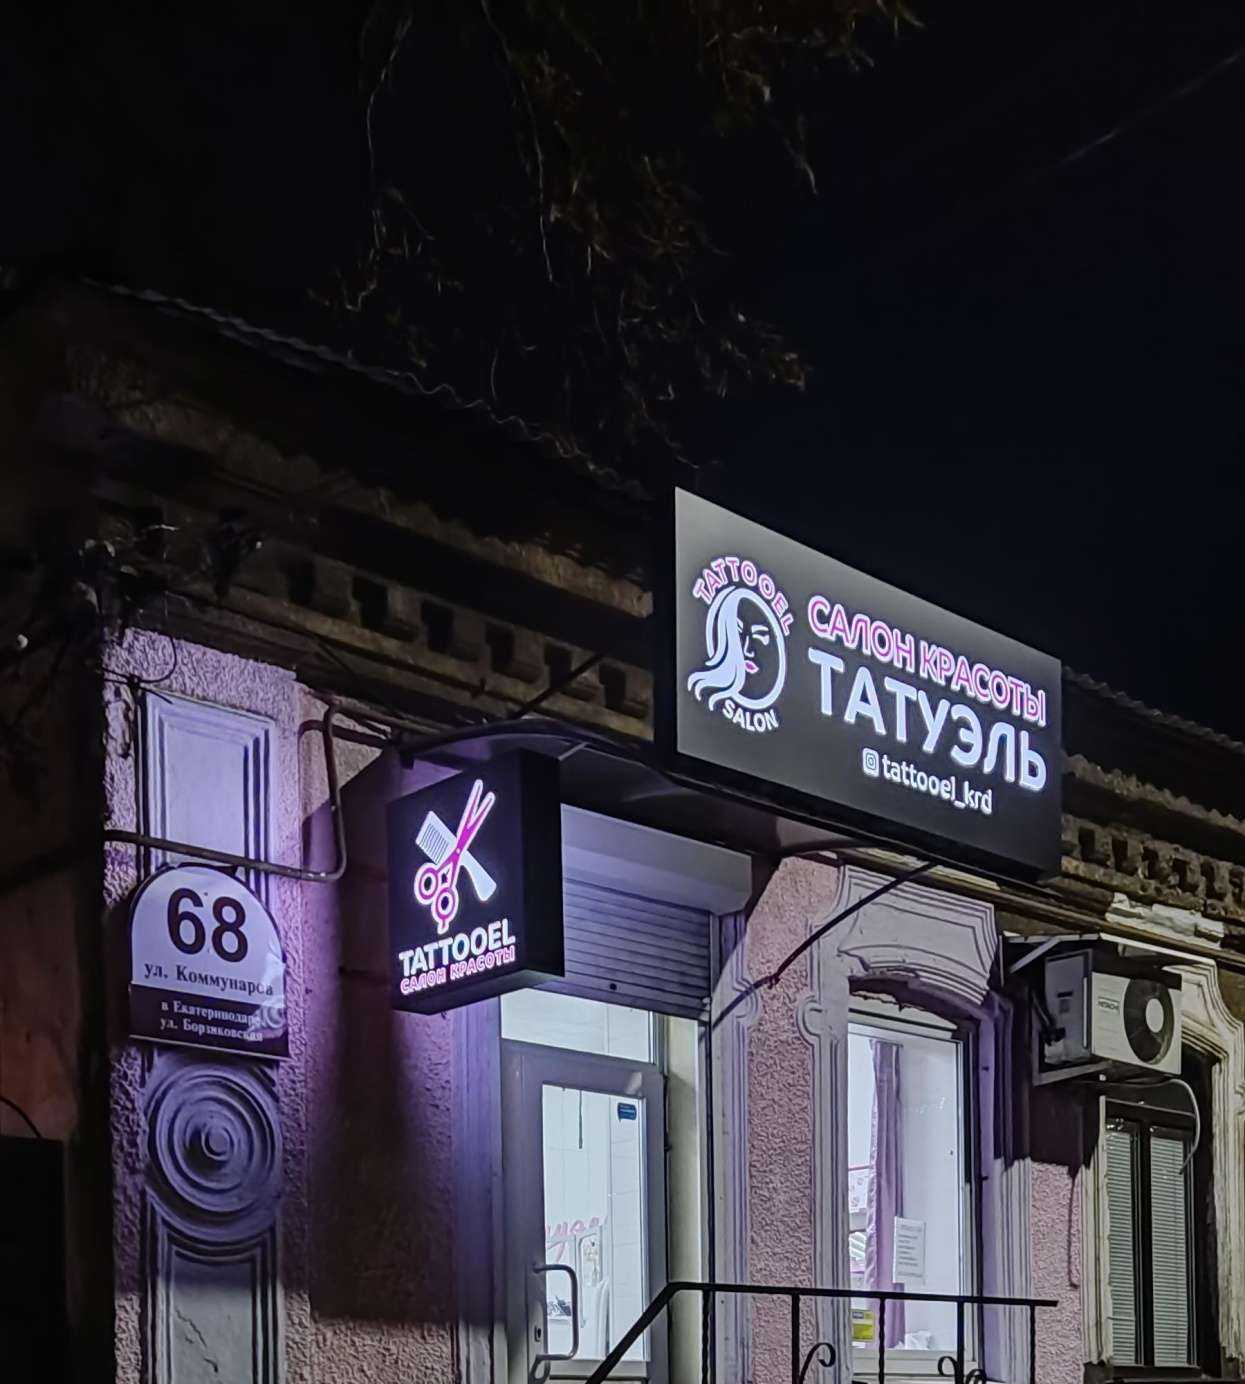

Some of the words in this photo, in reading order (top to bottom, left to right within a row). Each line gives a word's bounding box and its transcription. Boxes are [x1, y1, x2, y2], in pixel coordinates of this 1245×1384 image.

[693, 556, 795, 637] TATTOOEL
[807, 594, 916, 674] САЛОН
[918, 639, 1047, 728] КРАСОТЫ
[722, 699, 779, 734] SALON
[807, 646, 1048, 793] ТАТУЭЛЬ
[881, 753, 994, 816] tattooel_krd
[167, 887, 248, 963] 68
[398, 917, 516, 977] TATTOOEL
[144, 962, 168, 979] ул.
[399, 966, 447, 996] САЛОН
[449, 944, 516, 981] КРАСОТЫ
[160, 1017, 178, 1031] ул.
[161, 1001, 169, 1012] в
